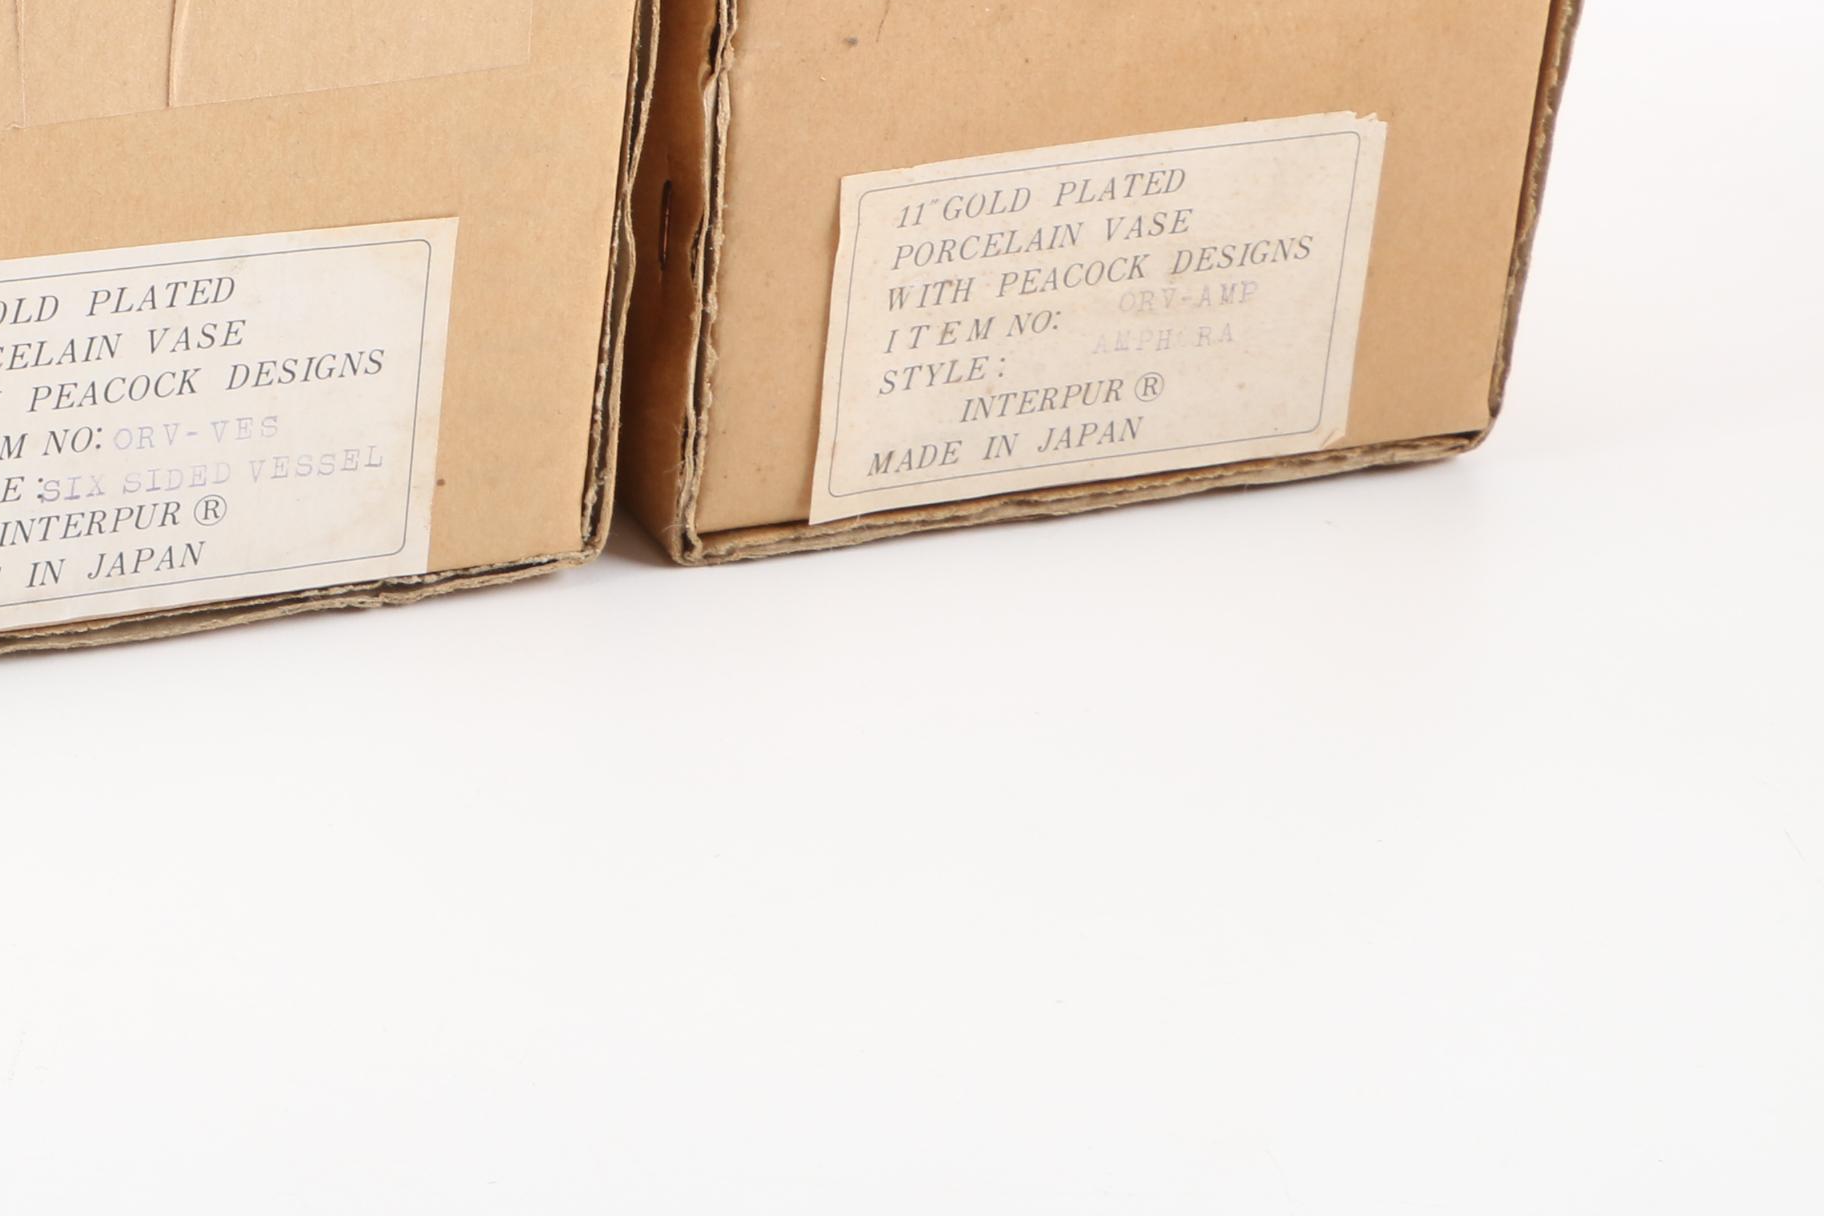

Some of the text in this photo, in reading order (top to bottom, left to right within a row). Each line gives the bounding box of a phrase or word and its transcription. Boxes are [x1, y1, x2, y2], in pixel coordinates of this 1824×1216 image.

[1053, 168, 1186, 208] PLATED
[890, 208, 1194, 271] PORCELAIN VASE
[888, 234, 1314, 312] WITH PEACOCK DESIGNS
[85, 276, 236, 318] PLATED
[147, 319, 247, 355] VASE
[883, 316, 996, 354] ITEM
[1005, 310, 1062, 338] NO:
[1091, 322, 1235, 354] AMPHRA
[26, 367, 203, 413] PEACOCK
[225, 348, 385, 391] DESIGNS
[41, 426, 103, 457] NO:
[113, 414, 280, 452] ORV-VES
[866, 415, 1144, 477] MADE IN JAPAN
[39, 476, 109, 505] SIX
[121, 461, 233, 496] SIDED
[248, 444, 385, 482] VESSEL
[25, 558, 67, 589] IN
[86, 540, 207, 580] JAPAN
